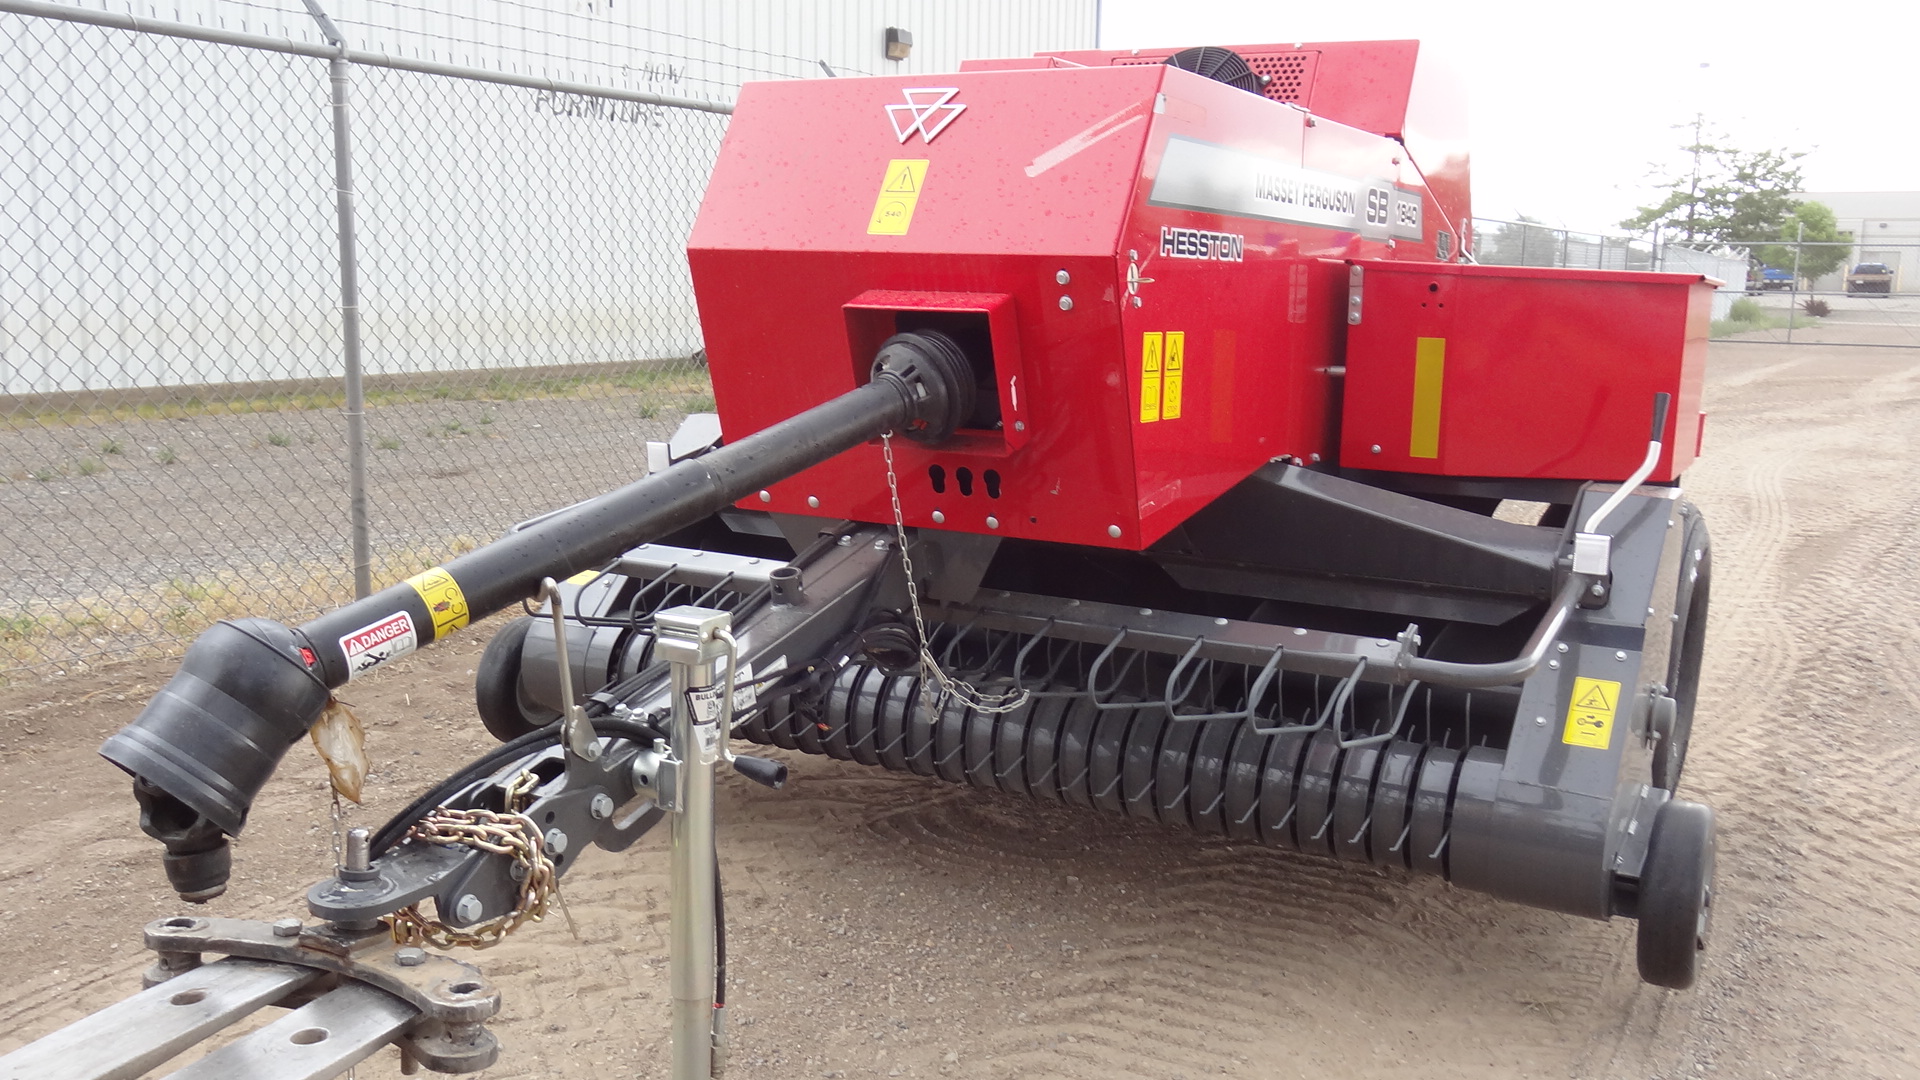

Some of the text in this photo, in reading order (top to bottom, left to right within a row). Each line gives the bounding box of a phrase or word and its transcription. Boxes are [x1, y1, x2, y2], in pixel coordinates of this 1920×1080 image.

[1254, 172, 1300, 206] MASSEY
[1302, 182, 1356, 216] FERGUSON
[1366, 187, 1390, 226] SB
[1160, 226, 1244, 263] HESSTON
[360, 618, 410, 648] DANGER
